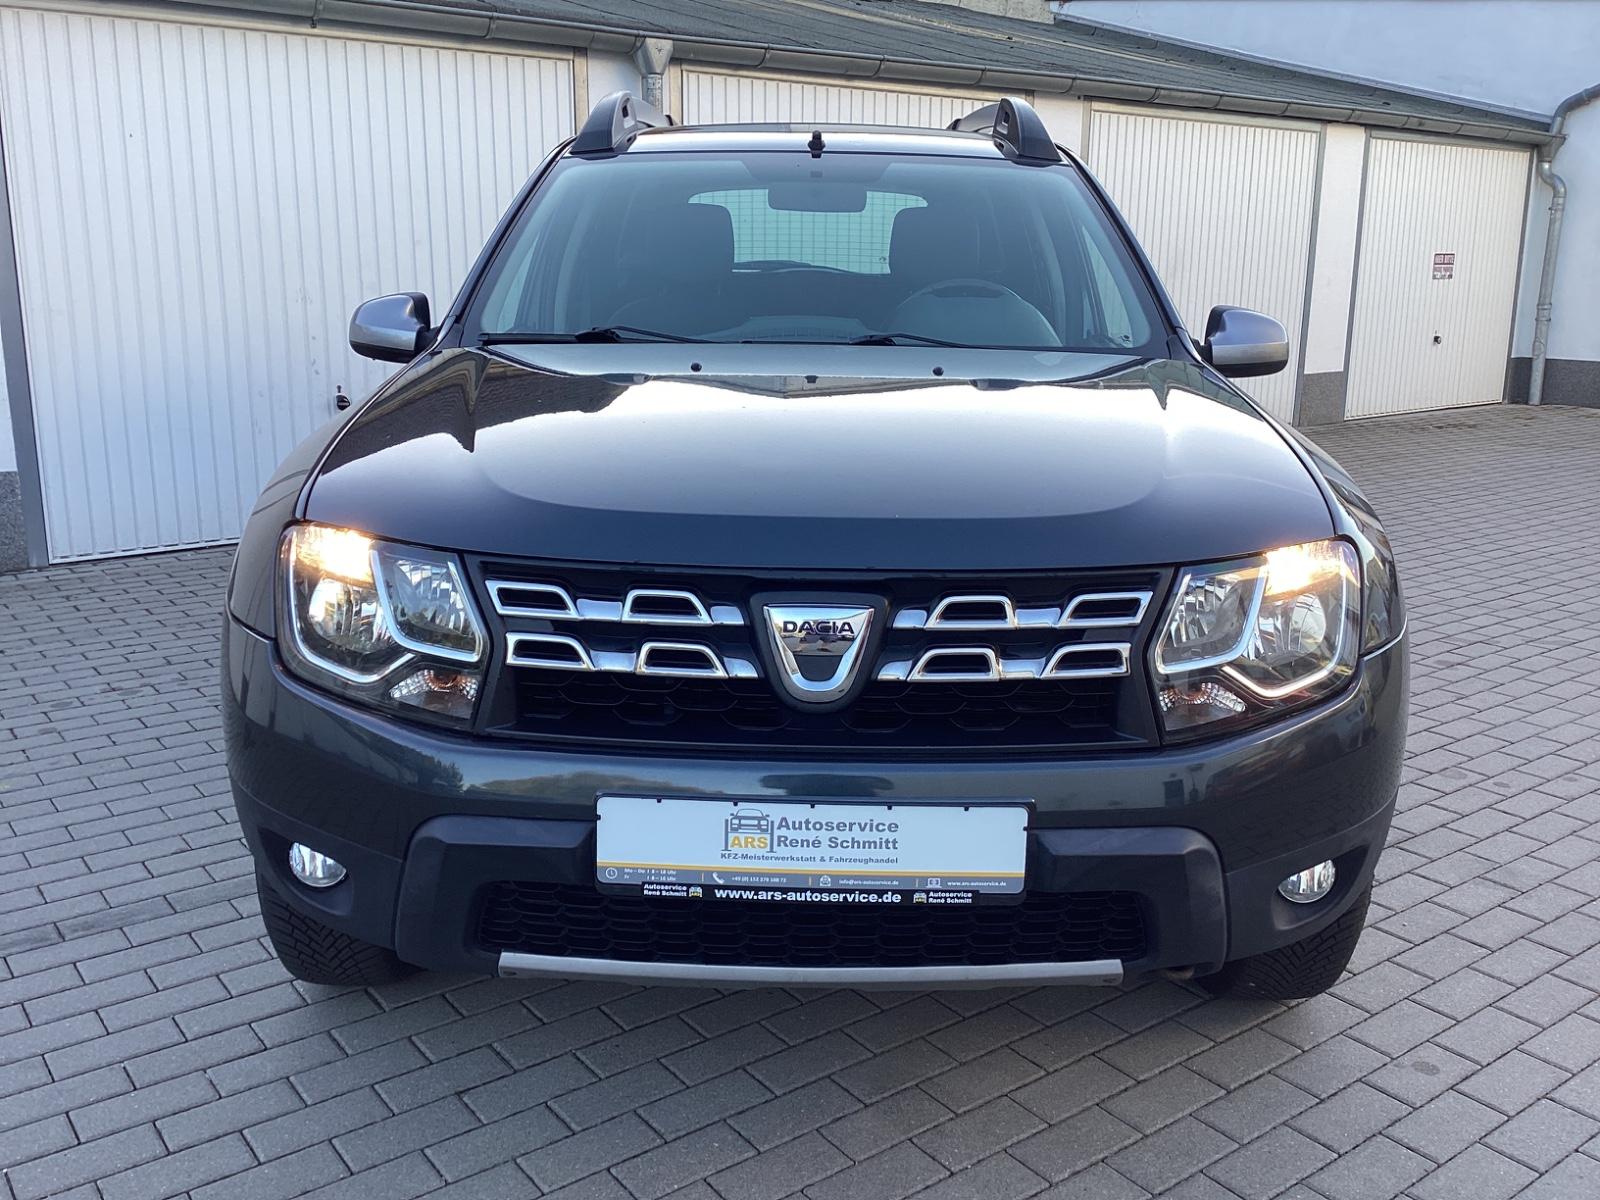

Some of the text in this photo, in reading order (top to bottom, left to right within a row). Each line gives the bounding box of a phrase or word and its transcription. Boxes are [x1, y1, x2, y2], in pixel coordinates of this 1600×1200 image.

[782, 620, 855, 634] DACIA
[776, 816, 899, 833] Autoservice
[730, 835, 769, 849] ARS
[776, 835, 898, 850] René Schmitt
[720, 852, 816, 862] KFZ-Meisterwerkstatt
[829, 856, 898, 865] Fahrzeughandel
[643, 883, 687, 891] Autoservice
[714, 888, 902, 903] www.ars-autoservice.de
